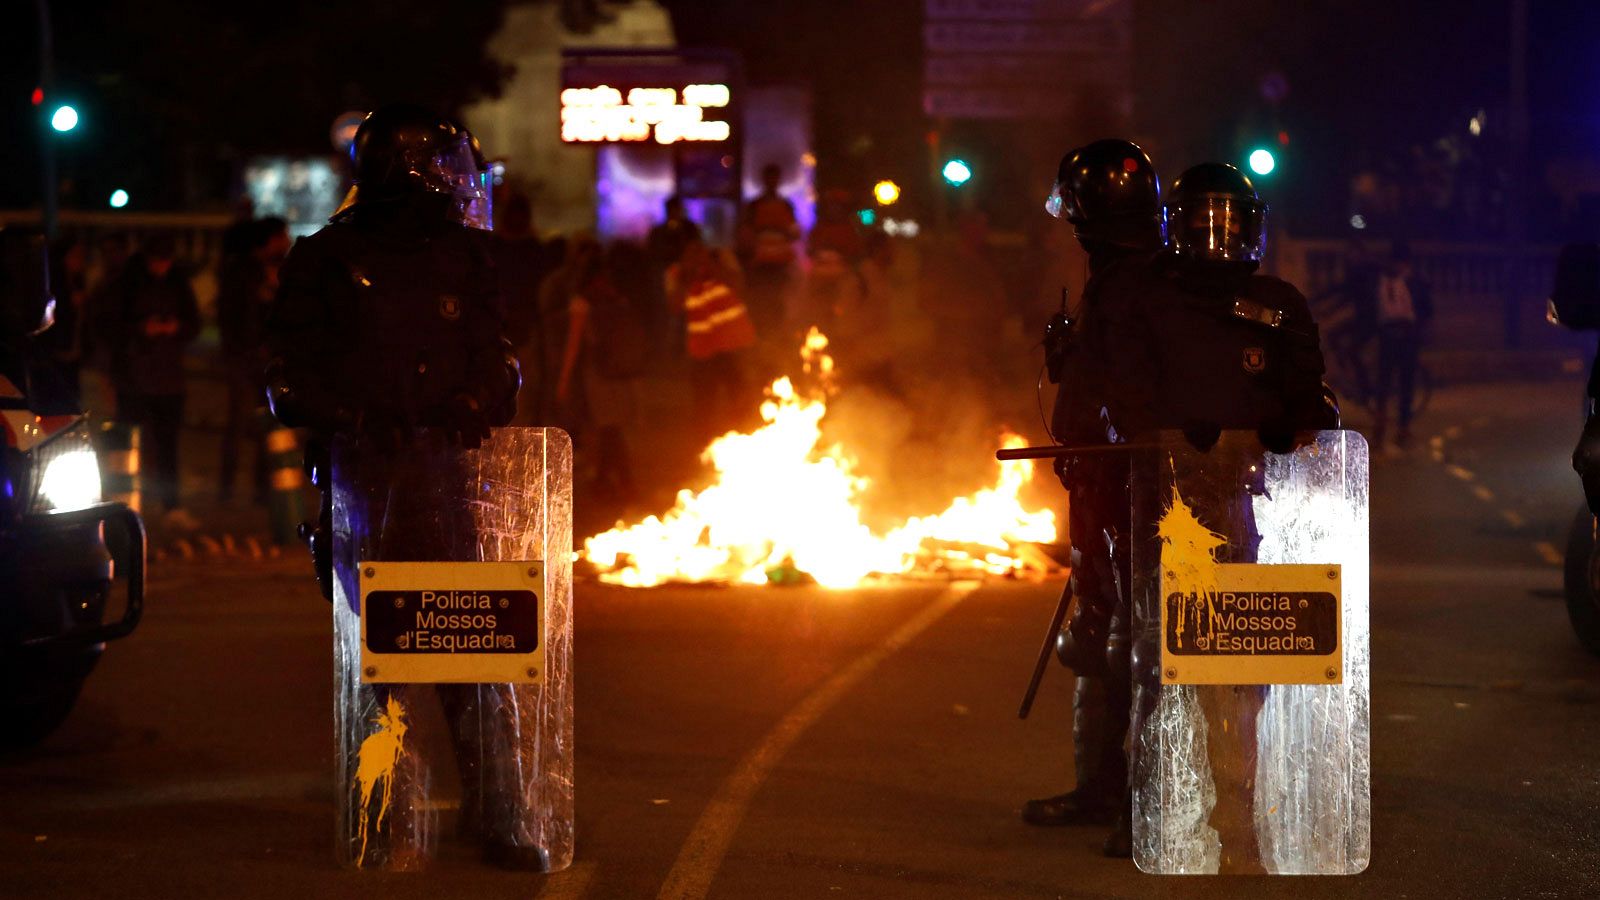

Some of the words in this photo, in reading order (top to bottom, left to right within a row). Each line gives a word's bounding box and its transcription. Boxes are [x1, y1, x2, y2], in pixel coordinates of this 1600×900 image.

[421, 591, 491, 609] Policia
[1222, 592, 1291, 611] Policia
[416, 611, 497, 629] Mossos
[1217, 612, 1297, 631] Mossos
[399, 631, 516, 653] d'Esquadra
[1198, 632, 1315, 654] dEsquadra
